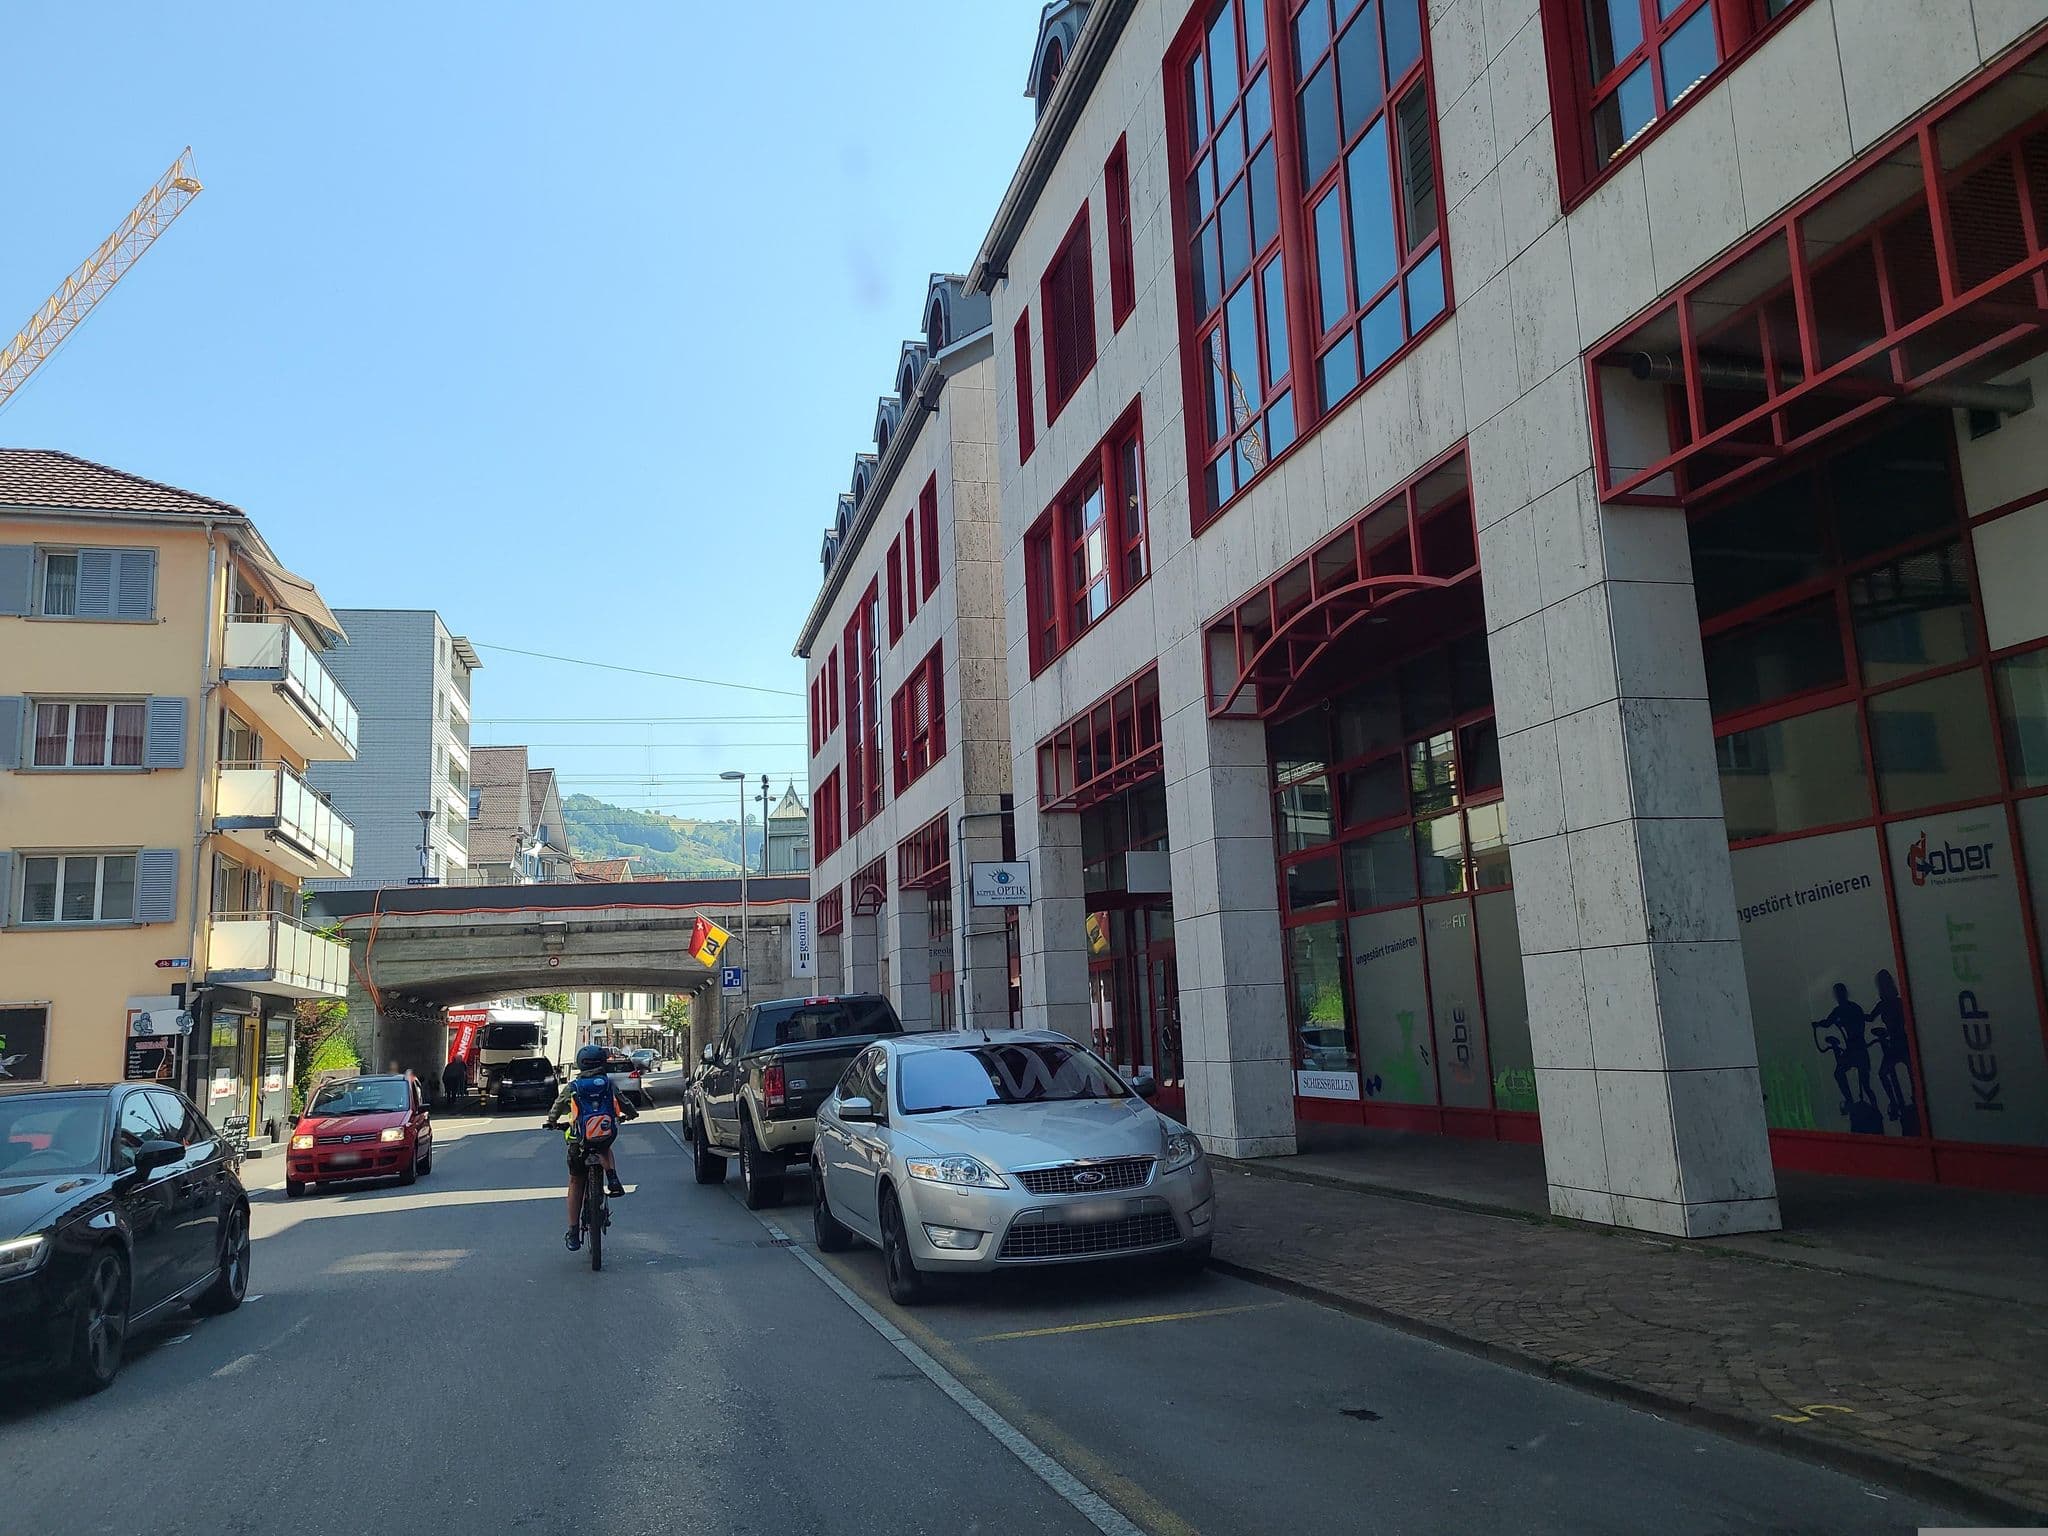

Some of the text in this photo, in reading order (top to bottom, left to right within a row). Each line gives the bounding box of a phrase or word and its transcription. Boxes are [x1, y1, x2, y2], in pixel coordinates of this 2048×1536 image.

[997, 886, 1026, 896] OPTIK
[1737, 873, 1871, 923] ngestört trainieren
[797, 911, 809, 952] geoinfra
[1355, 936, 1418, 965] ungestört trainieren
[724, 970, 734, 985] P
[449, 1014, 486, 1022] DENNER
[456, 1026, 472, 1056] NNER
[1303, 1076, 1355, 1092] SCHIESSBRILLEN
